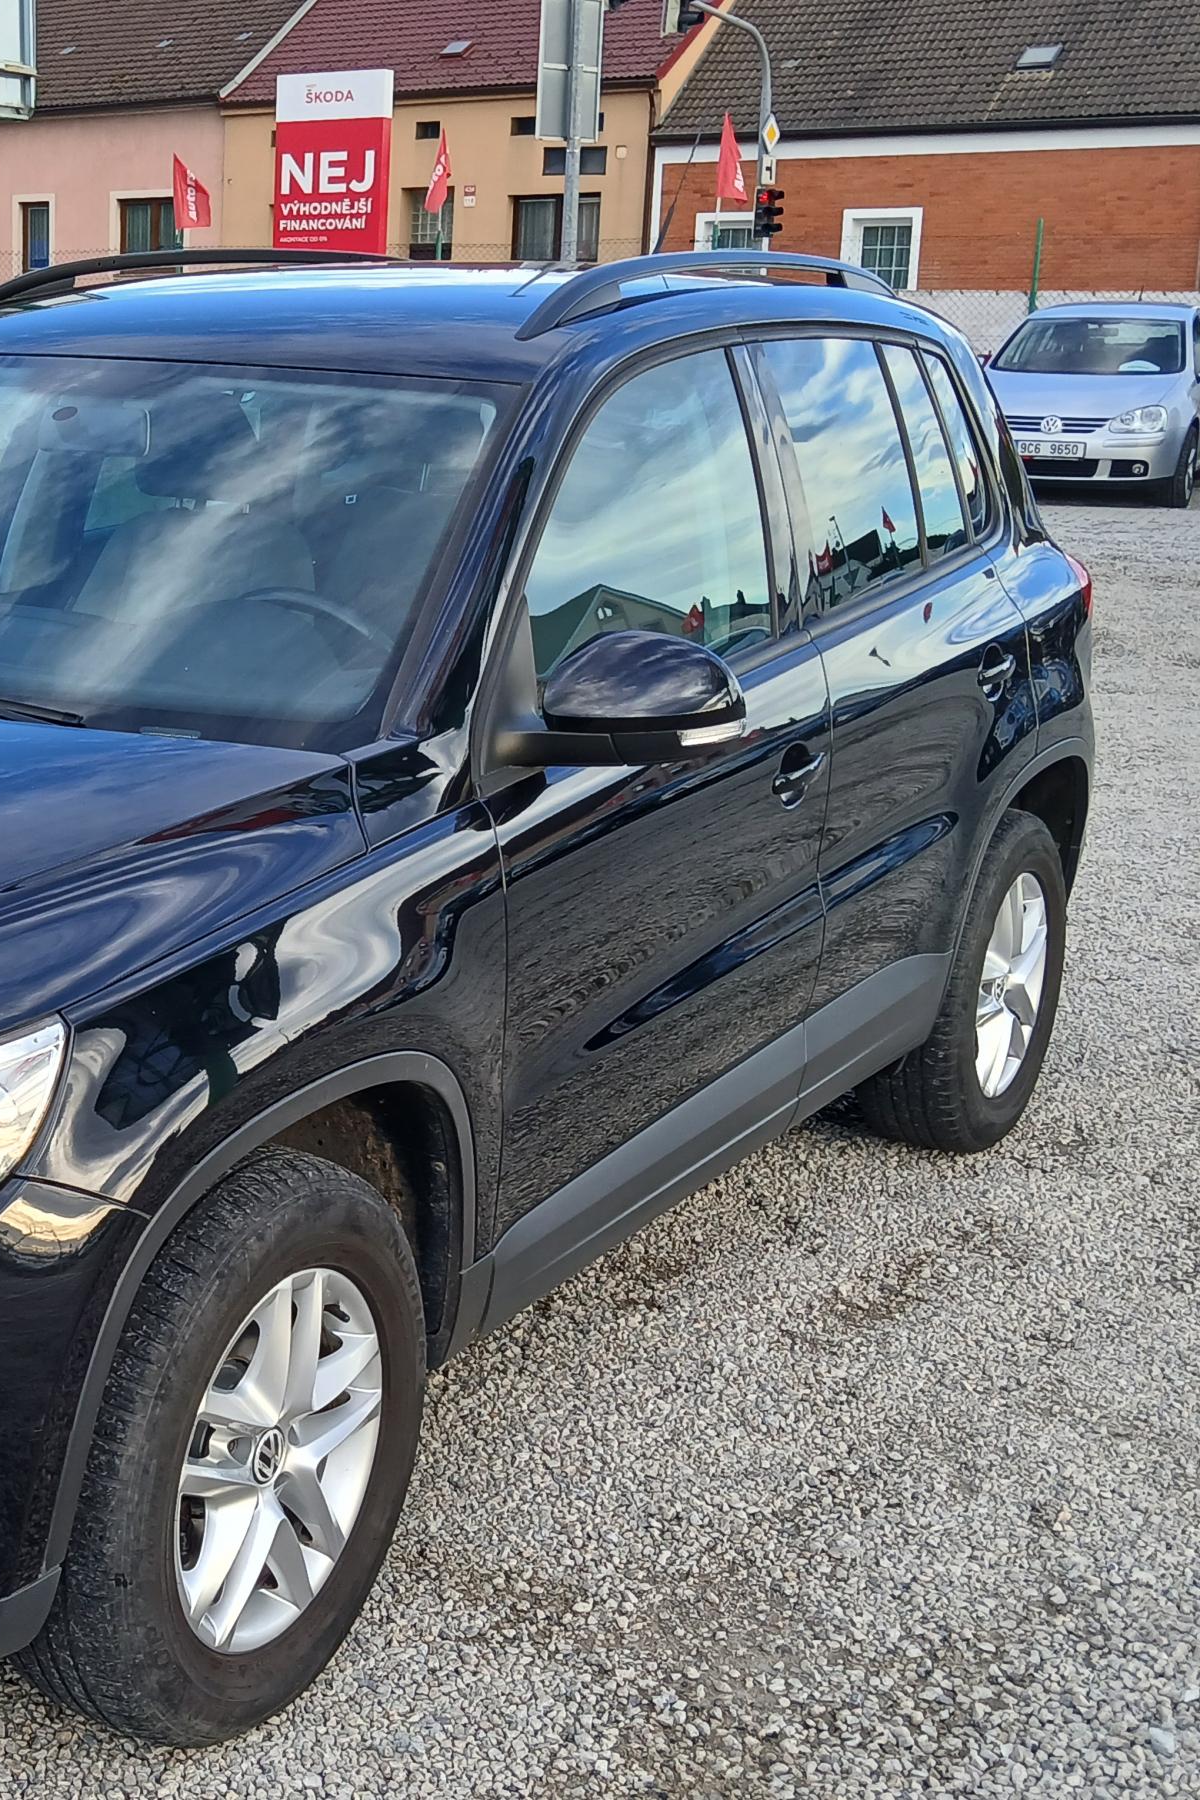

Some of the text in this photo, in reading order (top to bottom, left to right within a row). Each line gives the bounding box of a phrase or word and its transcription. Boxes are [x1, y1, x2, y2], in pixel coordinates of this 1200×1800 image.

[305, 89, 354, 104] ŠKODA
[280, 150, 376, 195] NEJ
[280, 198, 372, 216] VÝHODNĚJŠÍ
[279, 216, 366, 231] FINANCOVÁNÍ
[1020, 443, 1079, 455] 9C6 9650
